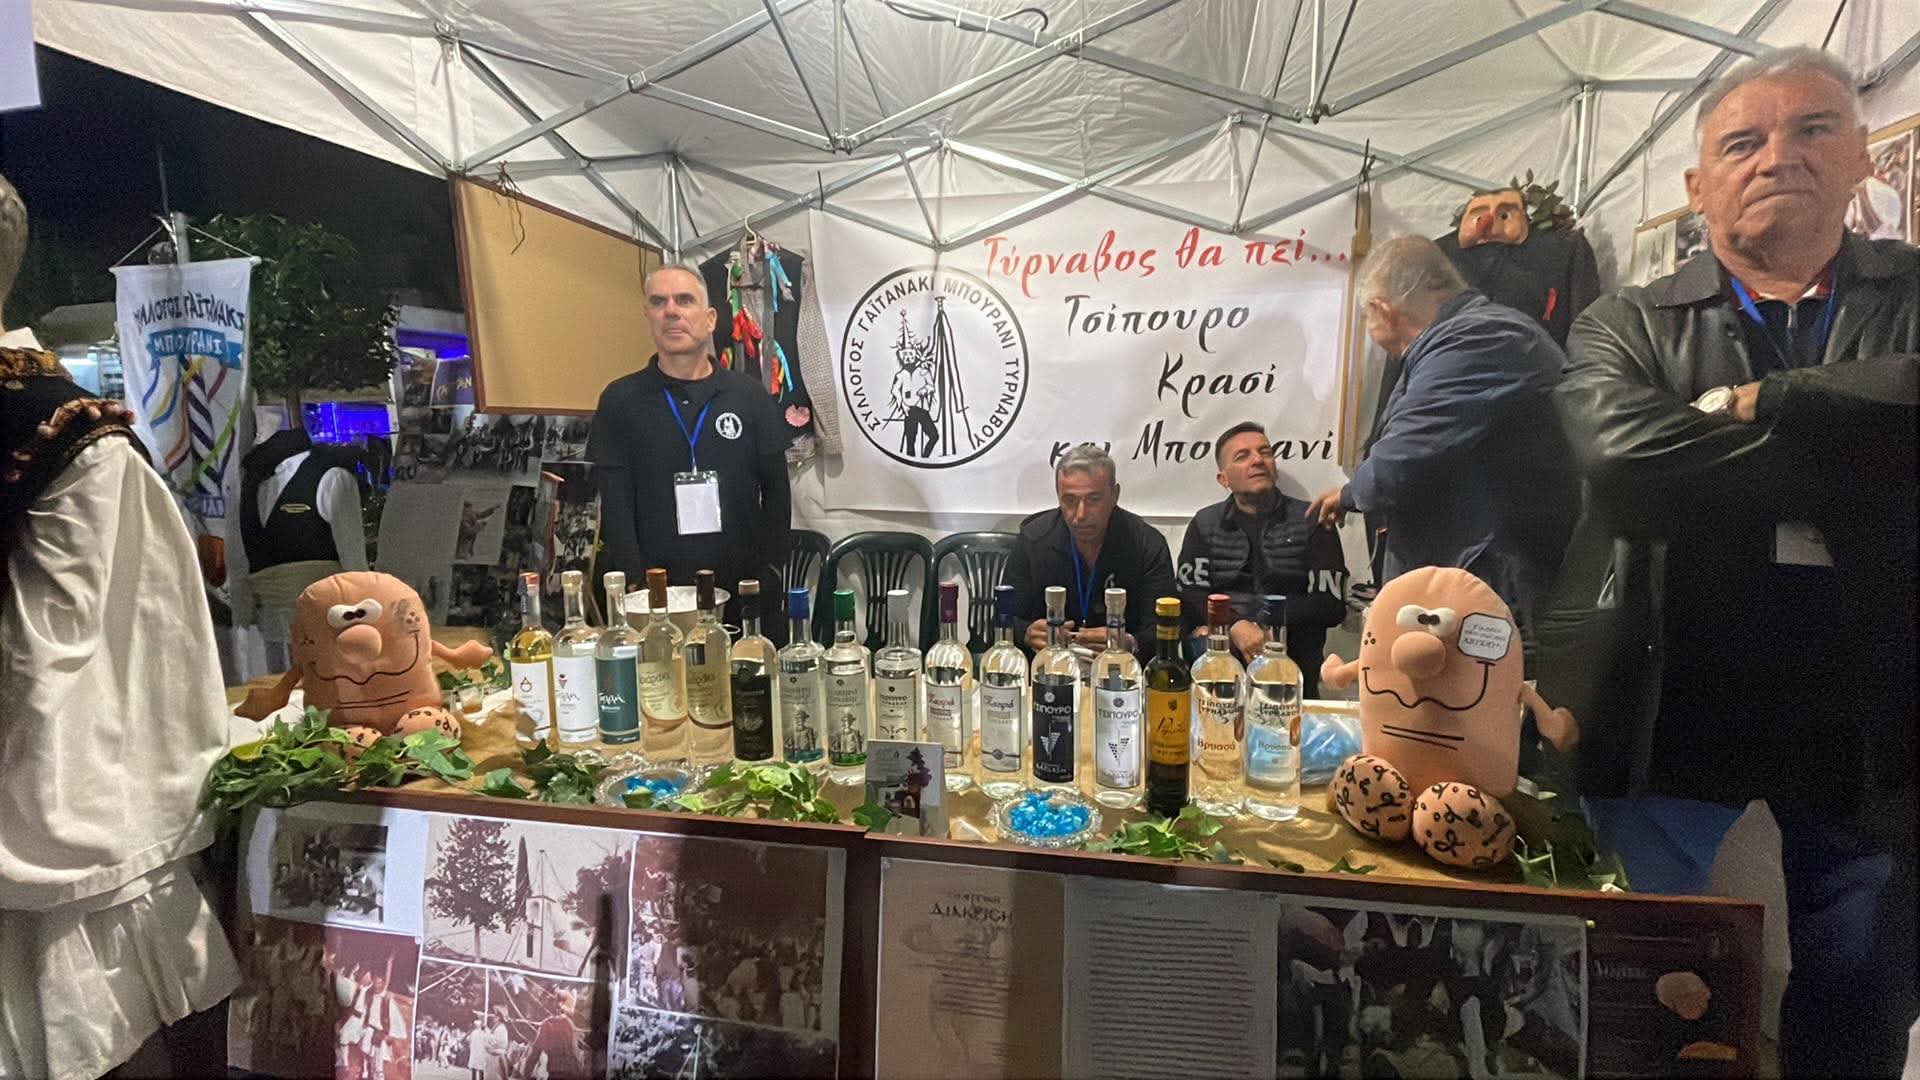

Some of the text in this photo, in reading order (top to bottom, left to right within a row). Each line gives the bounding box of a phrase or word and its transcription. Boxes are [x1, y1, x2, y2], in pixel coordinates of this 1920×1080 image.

[983, 229, 1157, 298] Τύρναβος
[1175, 225, 1226, 270] θα
[1064, 294, 1250, 353] Τσίπουρο
[848, 275, 1020, 448] ΣΥΛΛΟΓΟΣ ΓΑΪΤΑΝΑΚΙ ΜΠΟΥΡΑΝΙ ΤΥΡΝΑΒΟΥ
[1157, 351, 1278, 418] Κρασί
[1049, 419, 1335, 470] κι Μποανί
